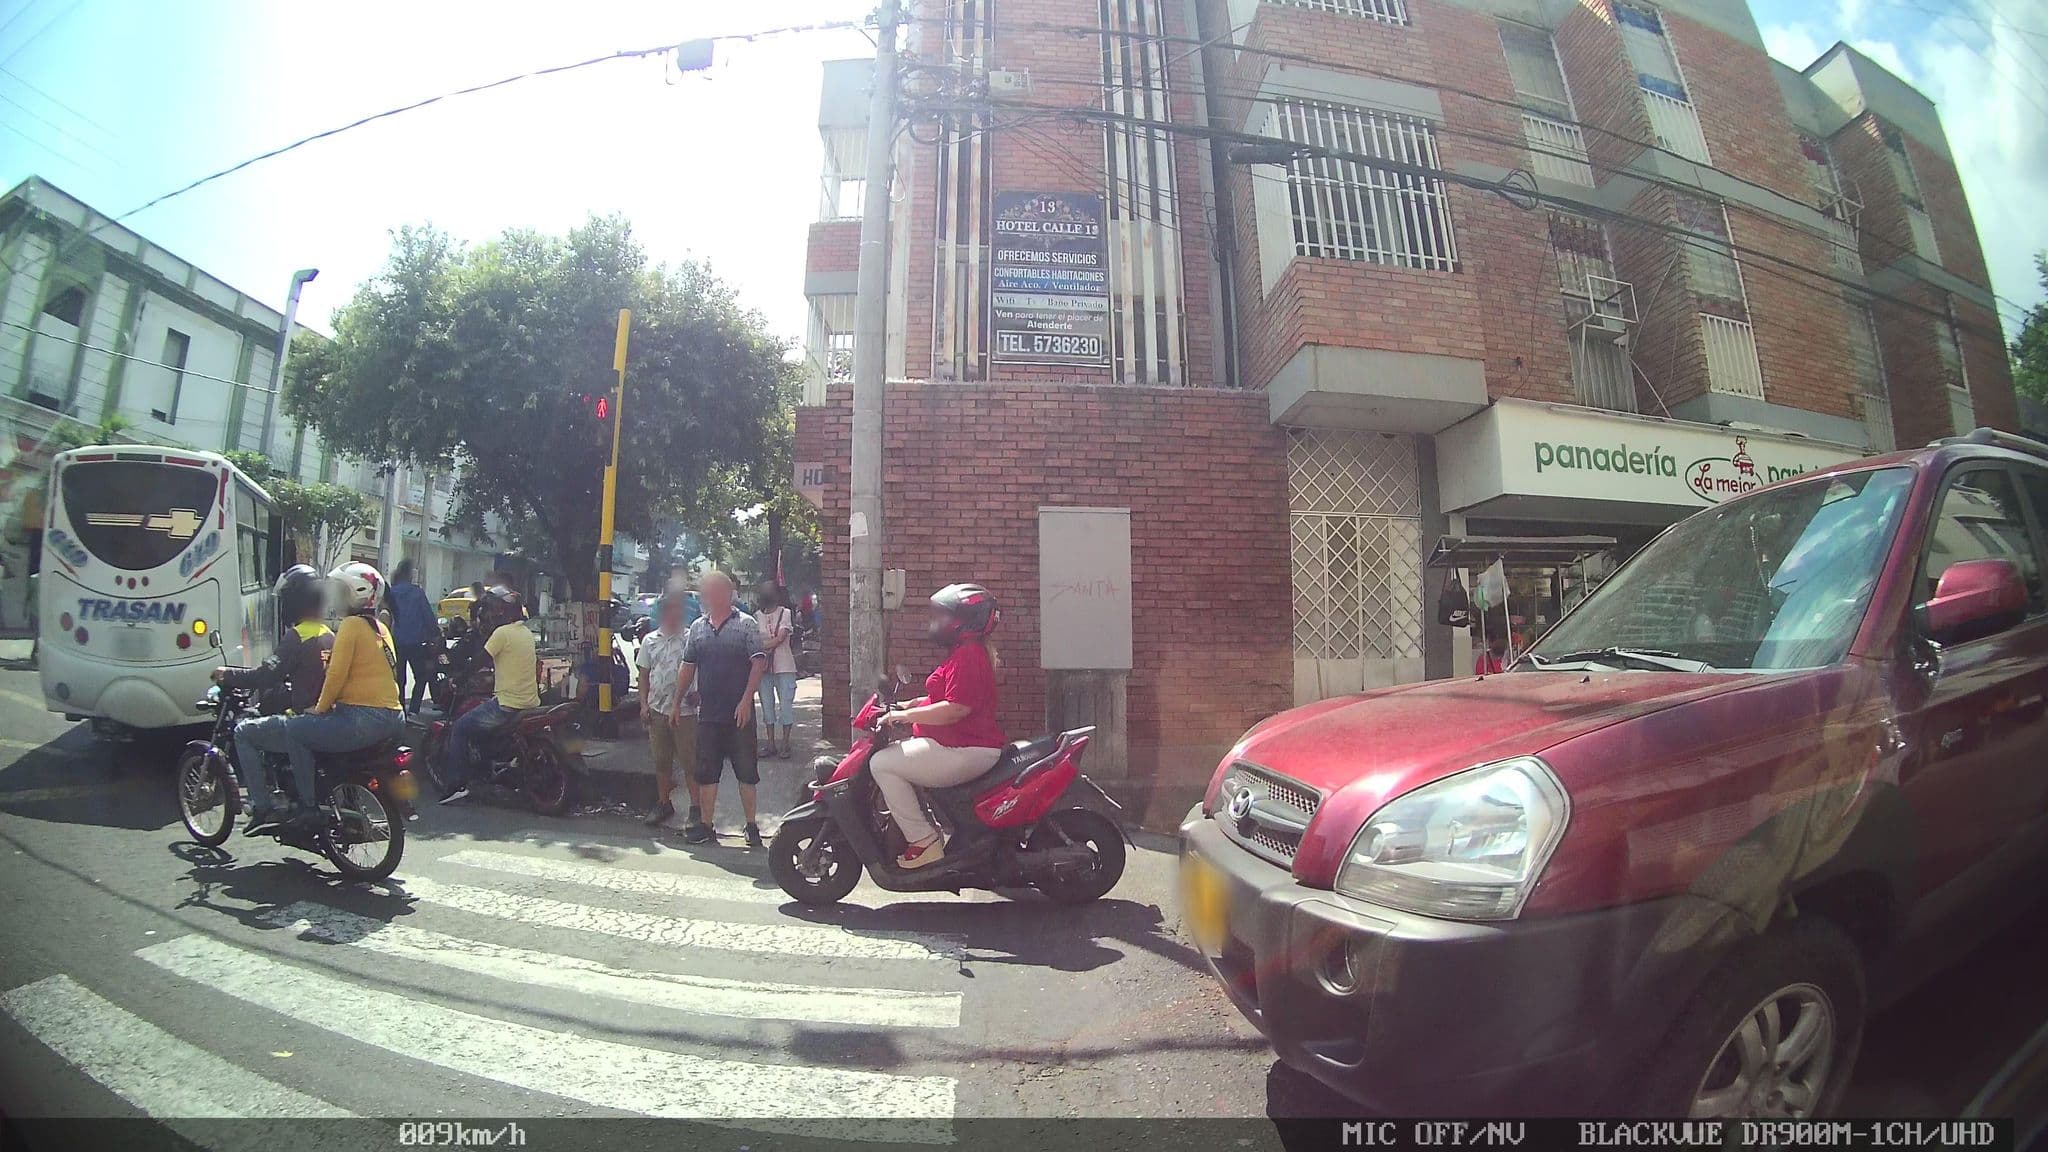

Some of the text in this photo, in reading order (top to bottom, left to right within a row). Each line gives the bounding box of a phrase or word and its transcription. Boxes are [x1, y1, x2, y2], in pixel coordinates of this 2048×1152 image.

[1040, 201, 1056, 213] 13
[996, 220, 1040, 232] HOTEL
[1085, 224, 1100, 235] 13
[998, 249, 1097, 265] OFRECEMOS SERVICIOS
[994, 267, 1105, 282] CONFORTABLES HABITACIONES
[998, 280, 1019, 288] Aire
[1052, 281, 1101, 292] Ventilador
[995, 309, 1014, 318] Ven
[1027, 320, 1073, 330] Atenderte
[1000, 334, 1099, 354] TEL. 5736230
[1535, 440, 1677, 477] panadería
[1694, 463, 1713, 494] La
[78, 598, 187, 624] TRASAN
